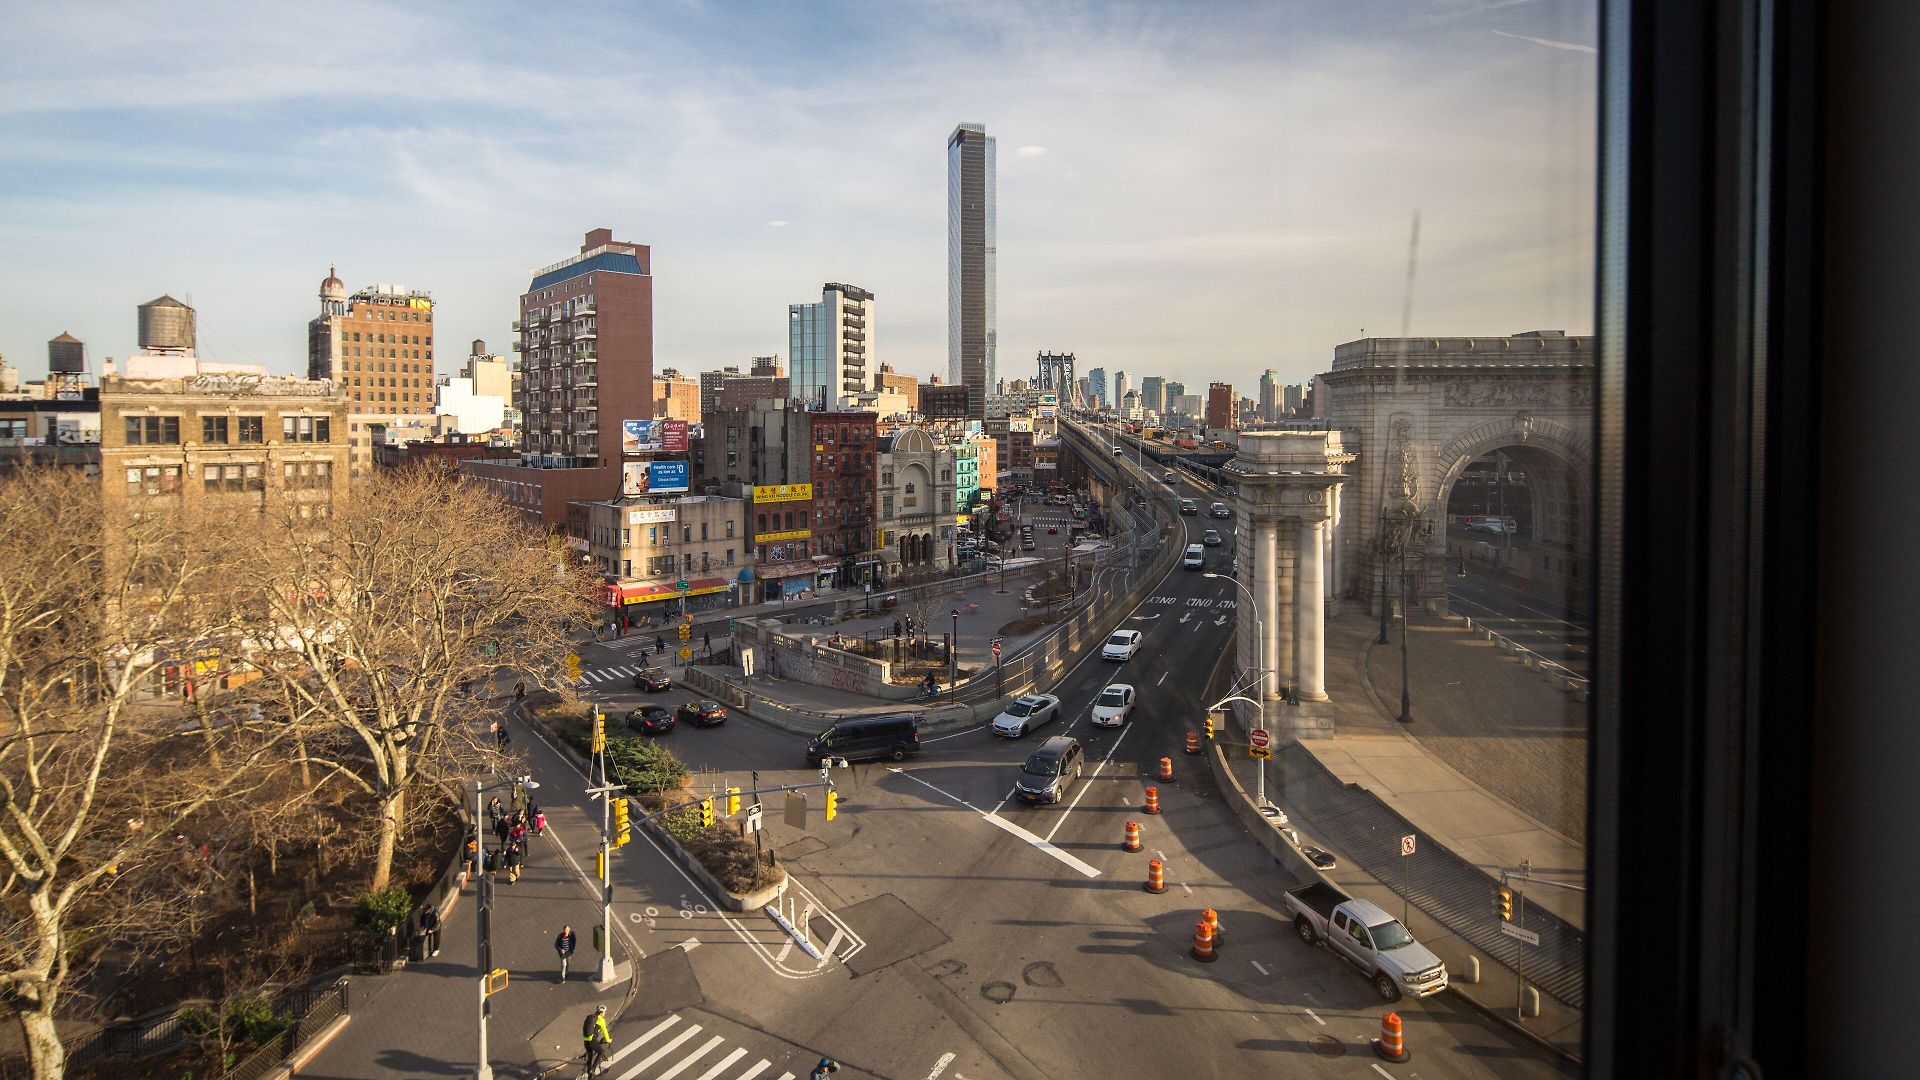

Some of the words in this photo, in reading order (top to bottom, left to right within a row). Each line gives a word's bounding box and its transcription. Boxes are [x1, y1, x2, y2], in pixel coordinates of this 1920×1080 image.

[1146, 596, 1177, 605] ONLY
[1185, 597, 1213, 607] ONLY
[1216, 600, 1237, 609] NLY
